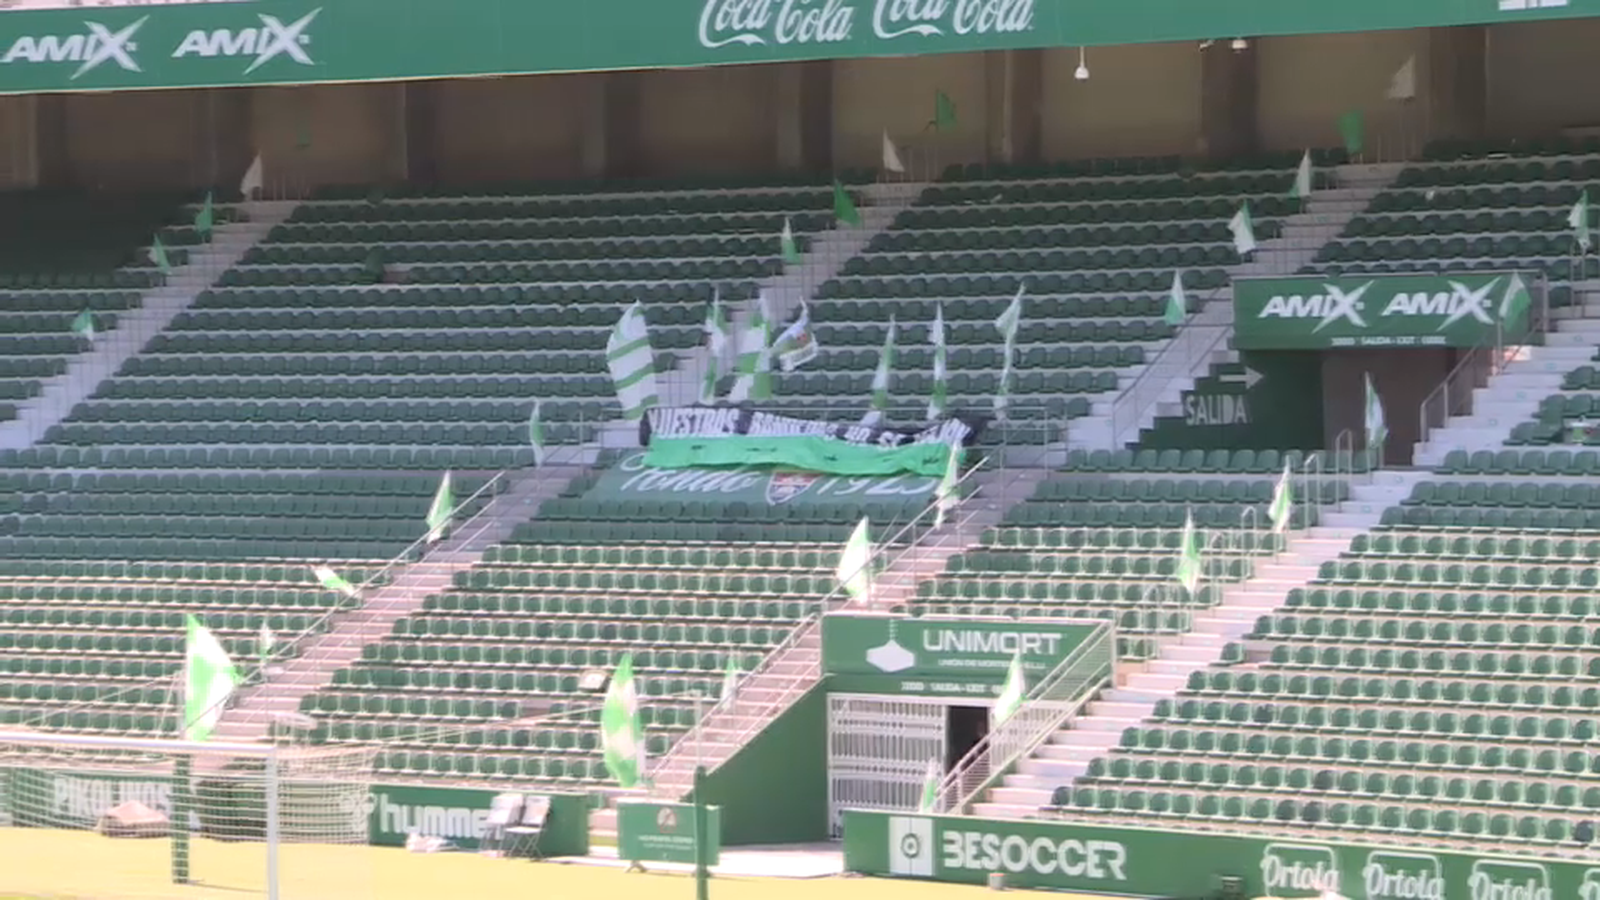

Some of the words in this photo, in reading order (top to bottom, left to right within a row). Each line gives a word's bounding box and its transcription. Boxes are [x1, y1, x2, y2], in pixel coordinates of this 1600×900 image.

[0, 14, 150, 80] AMIX
[171, 7, 323, 75] AMIX
[775, 0, 853, 43] Cola
[1258, 279, 1376, 334] AMIX
[1381, 277, 1501, 331] AMIX
[1185, 395, 1248, 425] SALIDA
[923, 629, 1062, 654] UNIMORT
[943, 830, 1127, 881] BESOCCER
